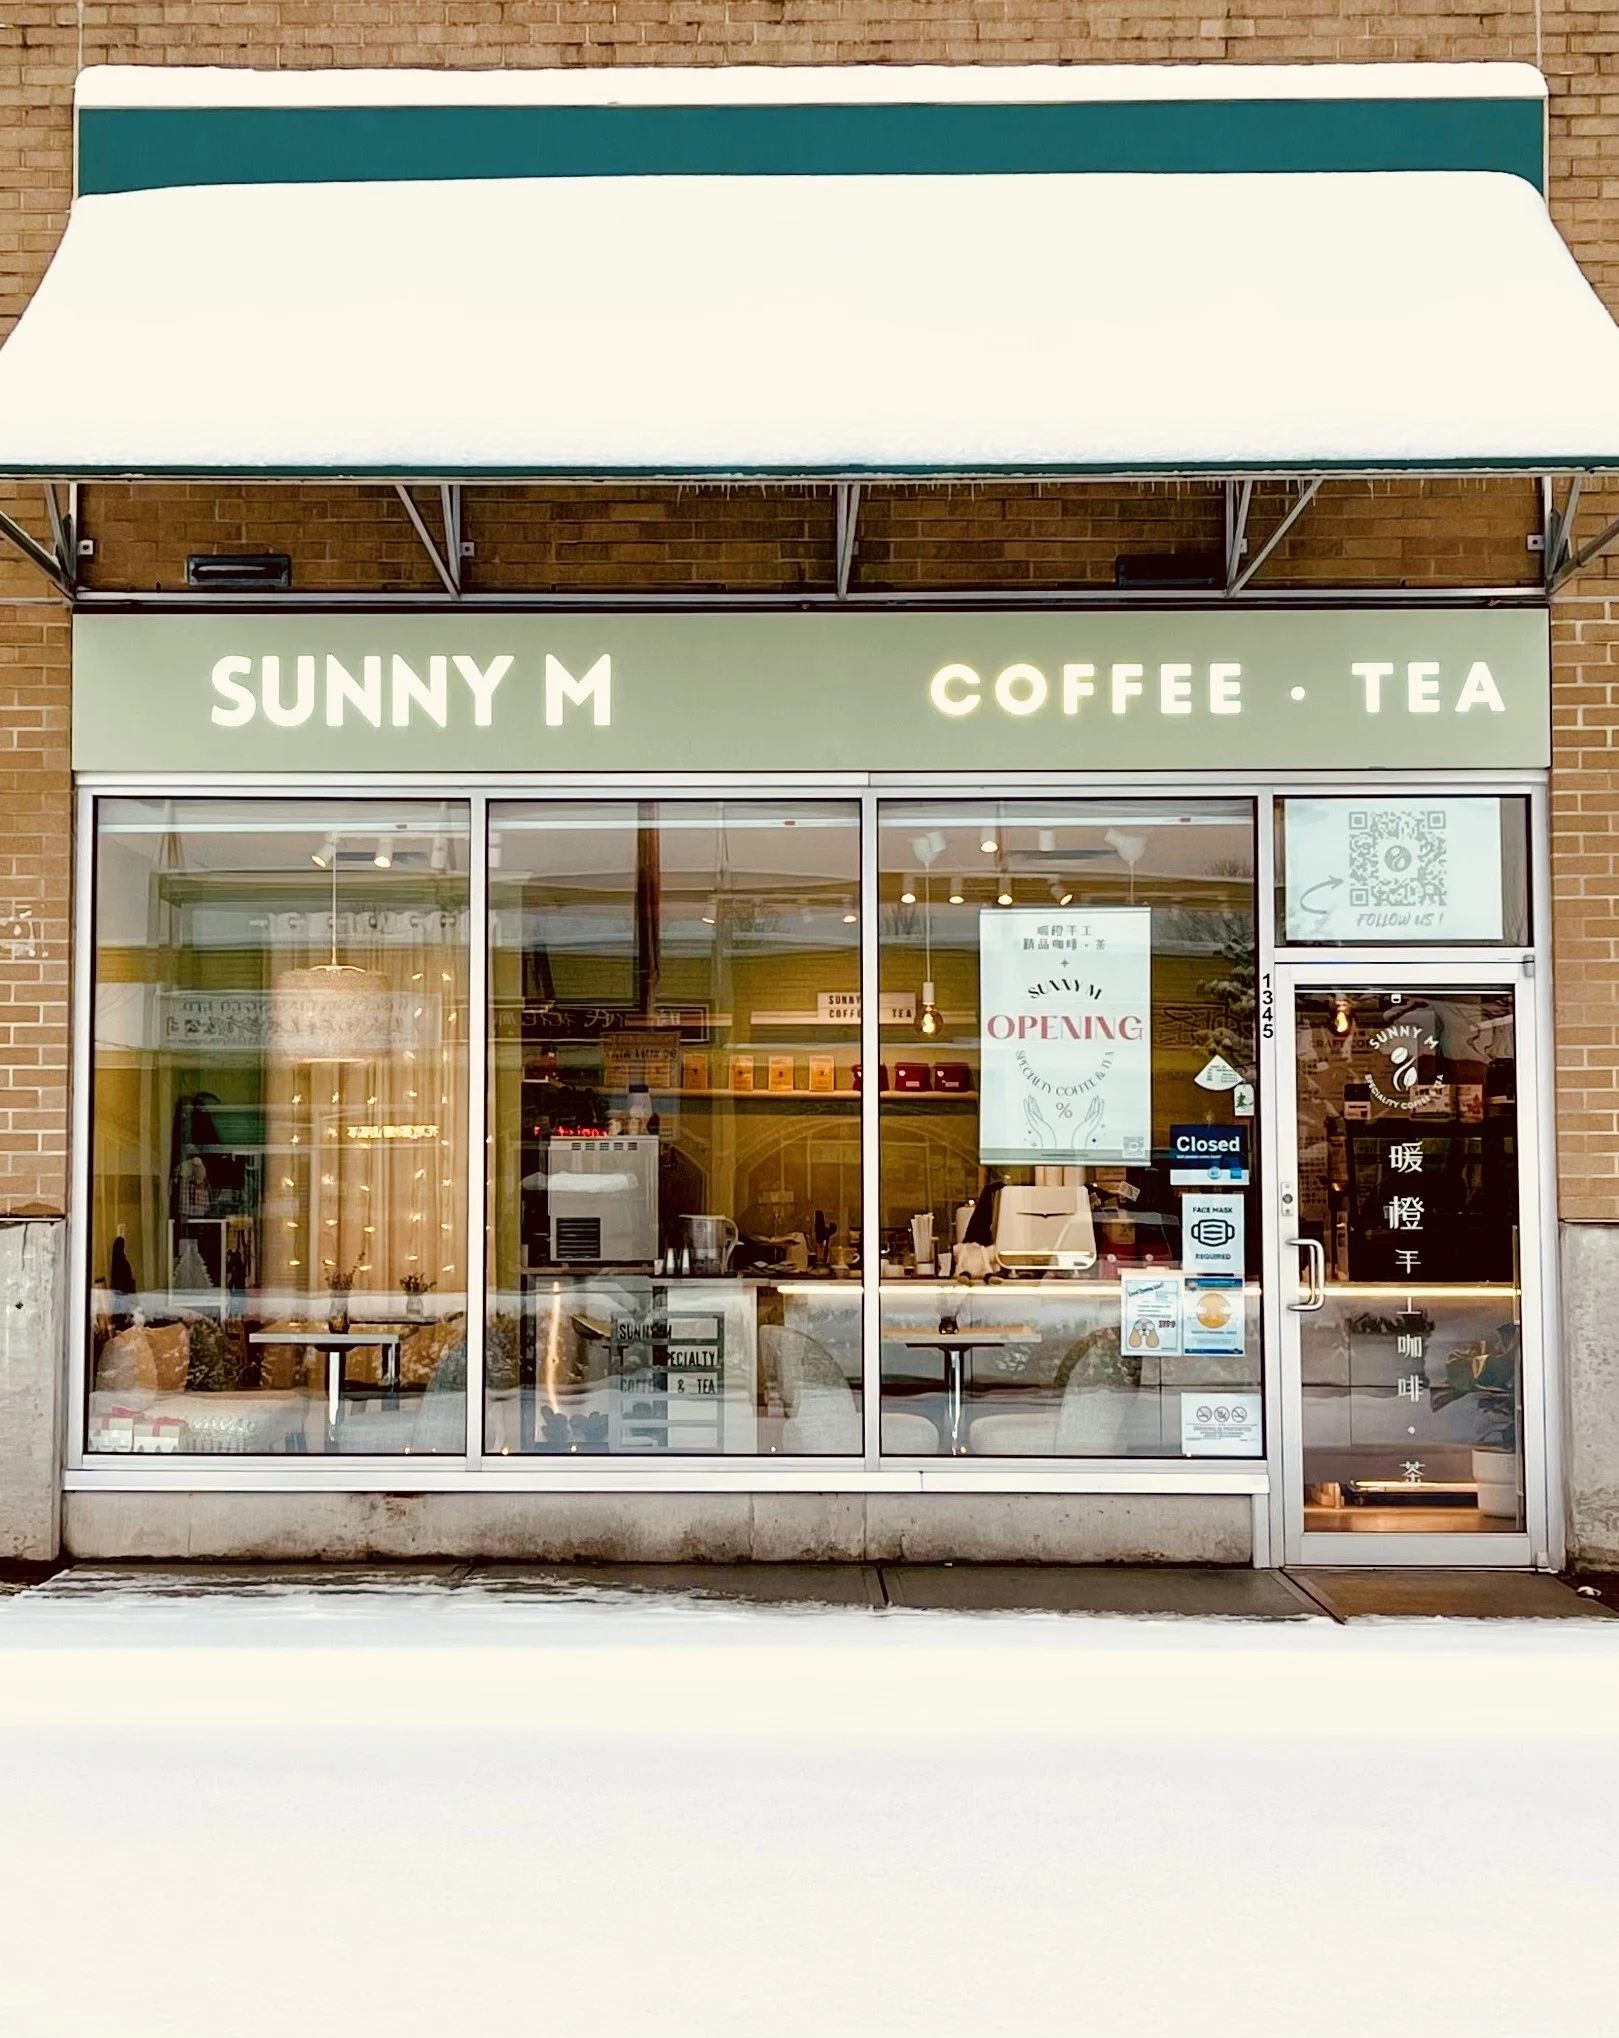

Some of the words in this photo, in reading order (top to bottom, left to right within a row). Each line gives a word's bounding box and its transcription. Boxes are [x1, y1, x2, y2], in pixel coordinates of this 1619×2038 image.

[211, 654, 515, 728] SUNNY
[545, 654, 611, 727] M
[930, 662, 1242, 716] COFFEE
[1351, 661, 1506, 714] TEA
[1356, 912, 1411, 927] FOLLOW
[1027, 978, 1082, 999] SUNNY
[1086, 984, 1103, 1000] M
[892, 1009, 912, 1018] TEA
[1262, 973, 1274, 1038] 1345
[987, 1014, 1144, 1041] OPENING
[1369, 1025, 1422, 1050] SUNNY
[1424, 1035, 1439, 1050] M
[1015, 1049, 1052, 1094] SPECIALTY
[1055, 1077, 1097, 1097] COFFEE
[1101, 1051, 1115, 1069] TEA
[1176, 1136, 1241, 1152] Closed
[678, 1379, 685, 1394] &
[697, 1379, 716, 1394] TEA
